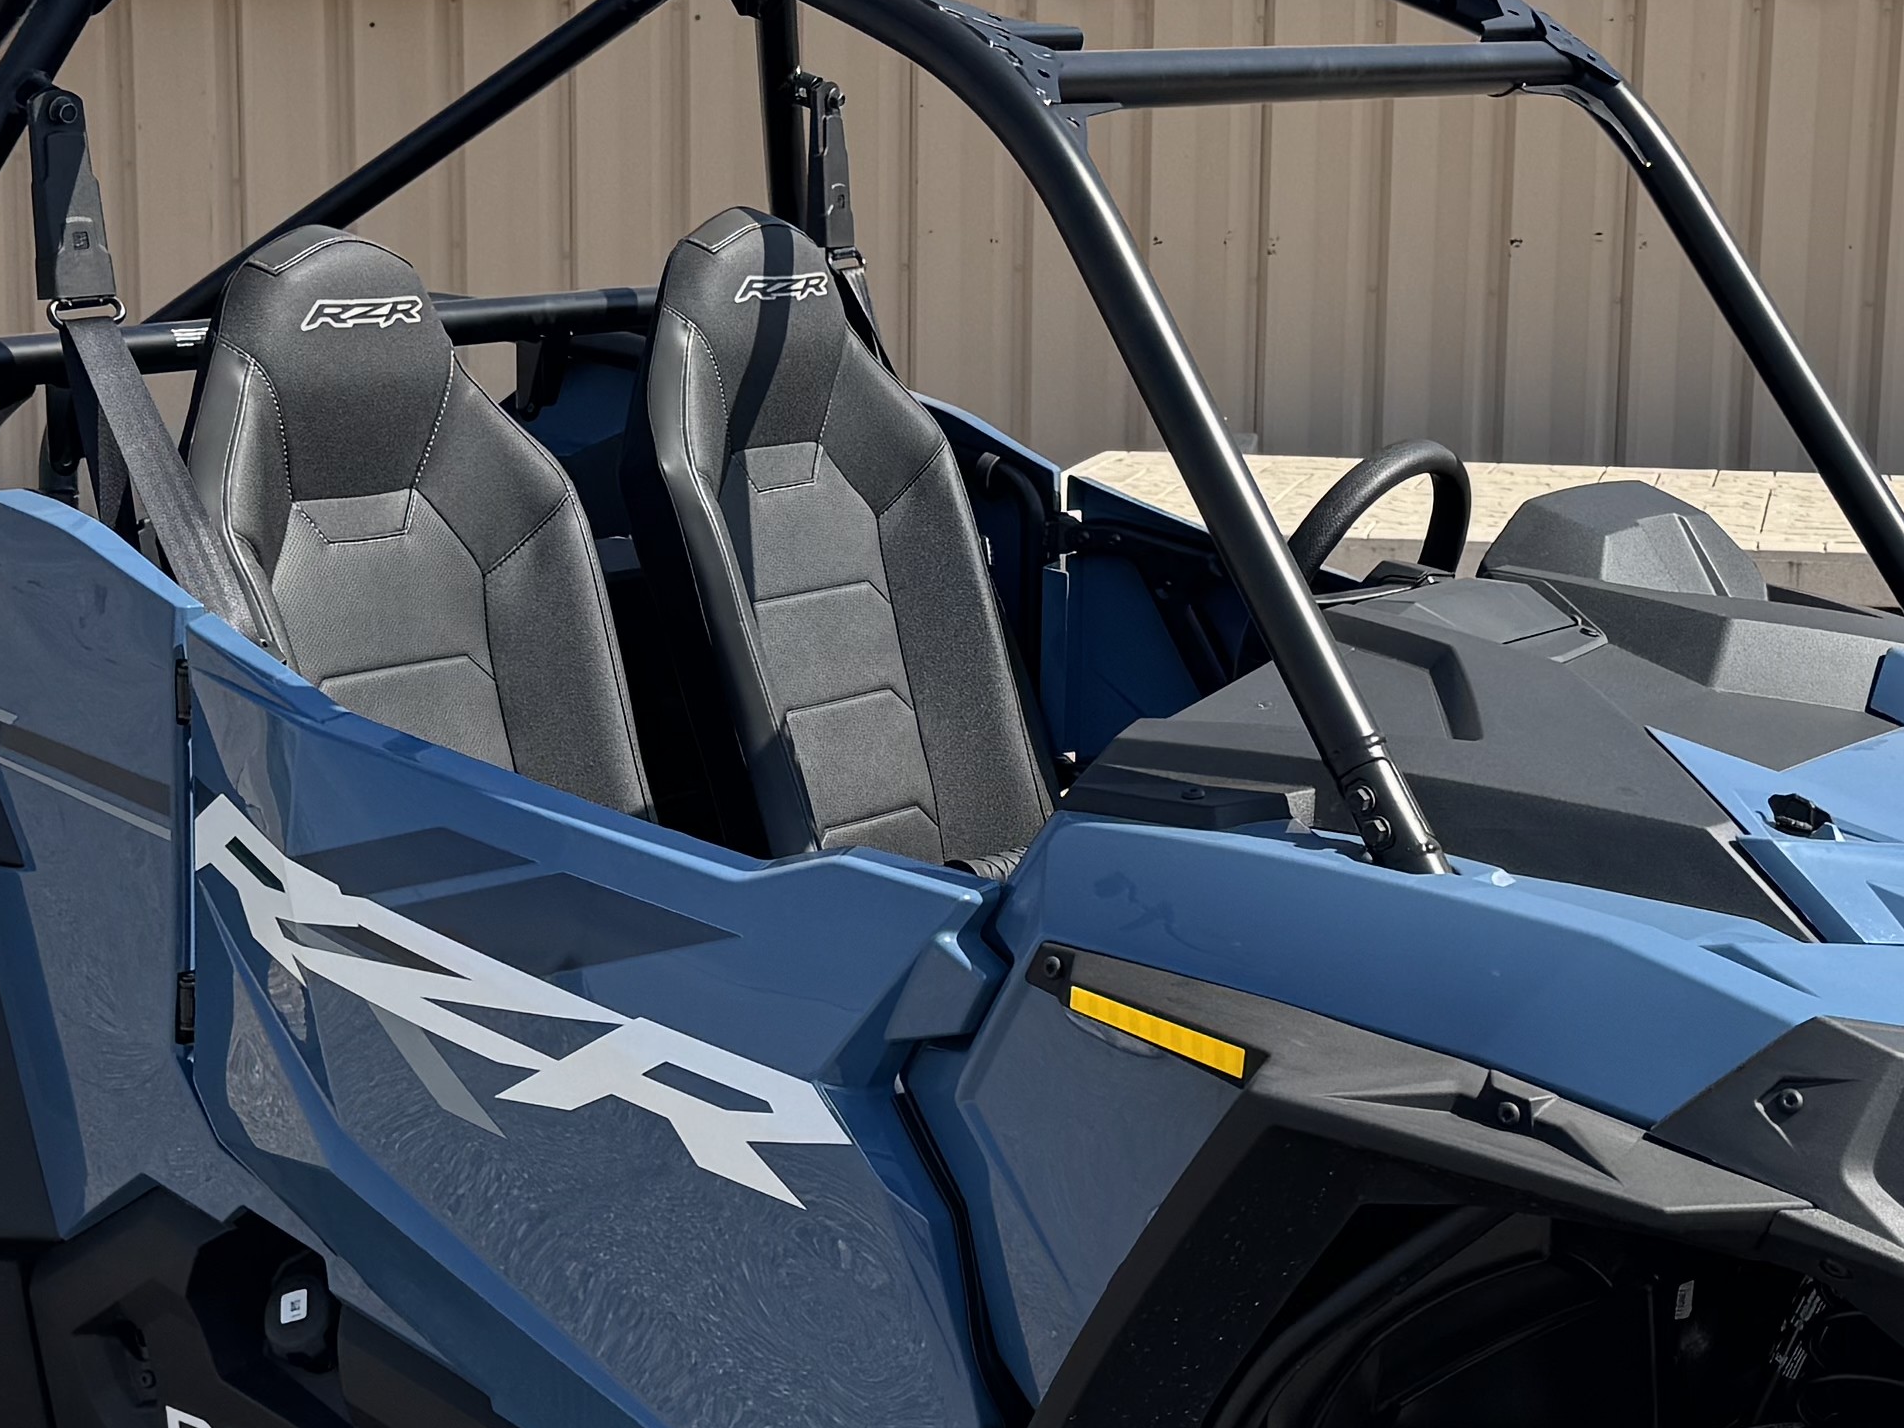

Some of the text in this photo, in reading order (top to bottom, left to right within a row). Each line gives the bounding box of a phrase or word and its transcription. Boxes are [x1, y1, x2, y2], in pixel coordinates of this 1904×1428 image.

[735, 272, 829, 304] RZR
[300, 295, 423, 332] RZR
[194, 793, 853, 1209] RZR
